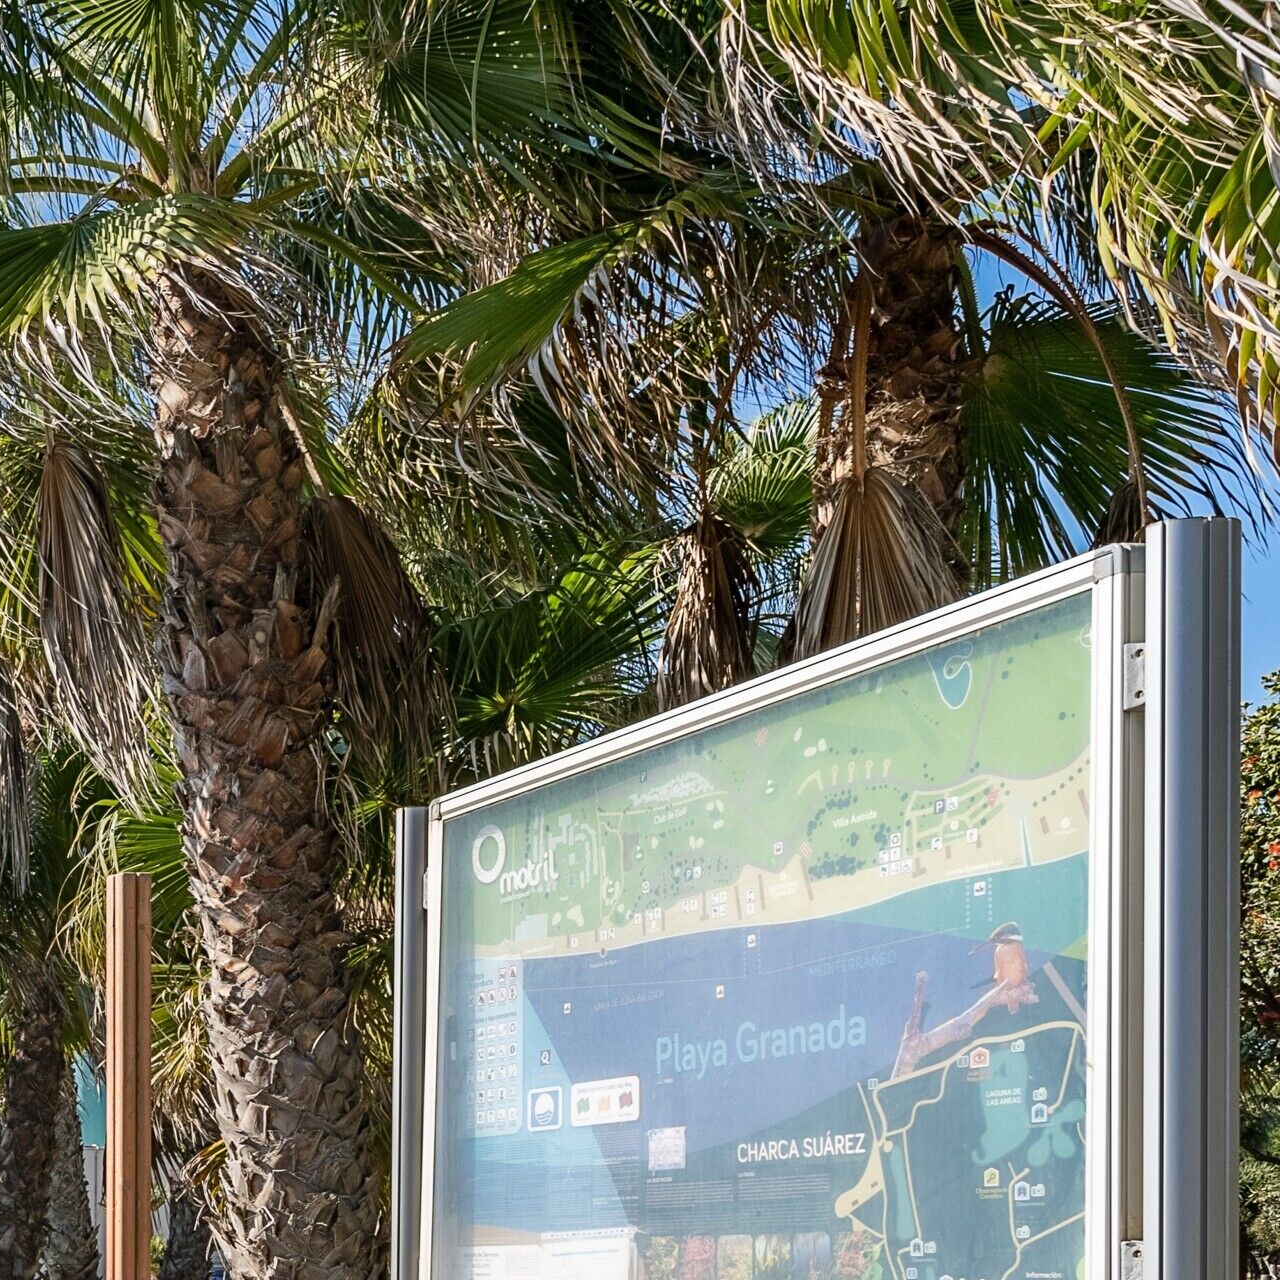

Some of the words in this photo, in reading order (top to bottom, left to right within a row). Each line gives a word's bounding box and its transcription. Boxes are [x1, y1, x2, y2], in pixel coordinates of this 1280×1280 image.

[653, 812, 668, 825] Club
[675, 806, 688, 819] Golf
[832, 816, 849, 829] Villa
[850, 809, 878, 825] Astrida
[499, 850, 559, 894] motril
[655, 1032, 728, 1080] Playa
[736, 1003, 867, 1063] Granada
[986, 1088, 1011, 1098] LAGUNA
[986, 1098, 998, 1106] LAS
[737, 1139, 799, 1163] CHARCA
[803, 1130, 866, 1158] SUÁREZ
